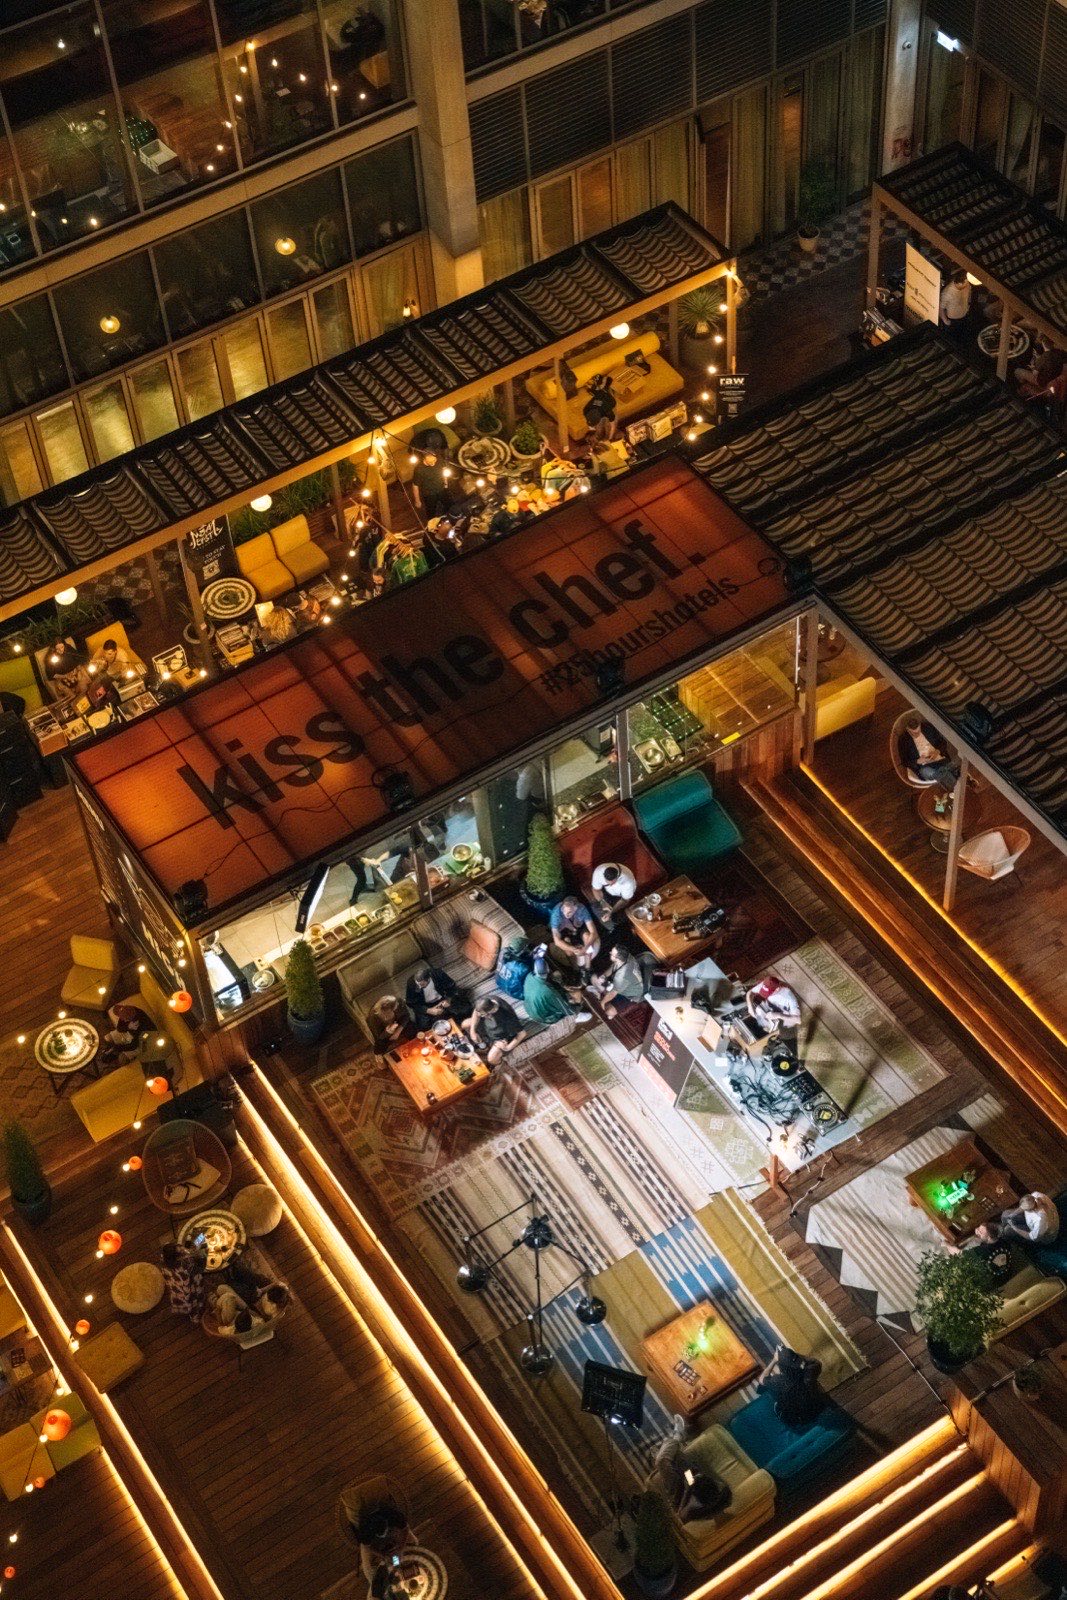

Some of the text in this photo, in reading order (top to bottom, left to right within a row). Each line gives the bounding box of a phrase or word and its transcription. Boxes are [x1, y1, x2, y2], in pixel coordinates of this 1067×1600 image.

[719, 377, 745, 386] raw
[177, 518, 707, 830] kiss the chef.
